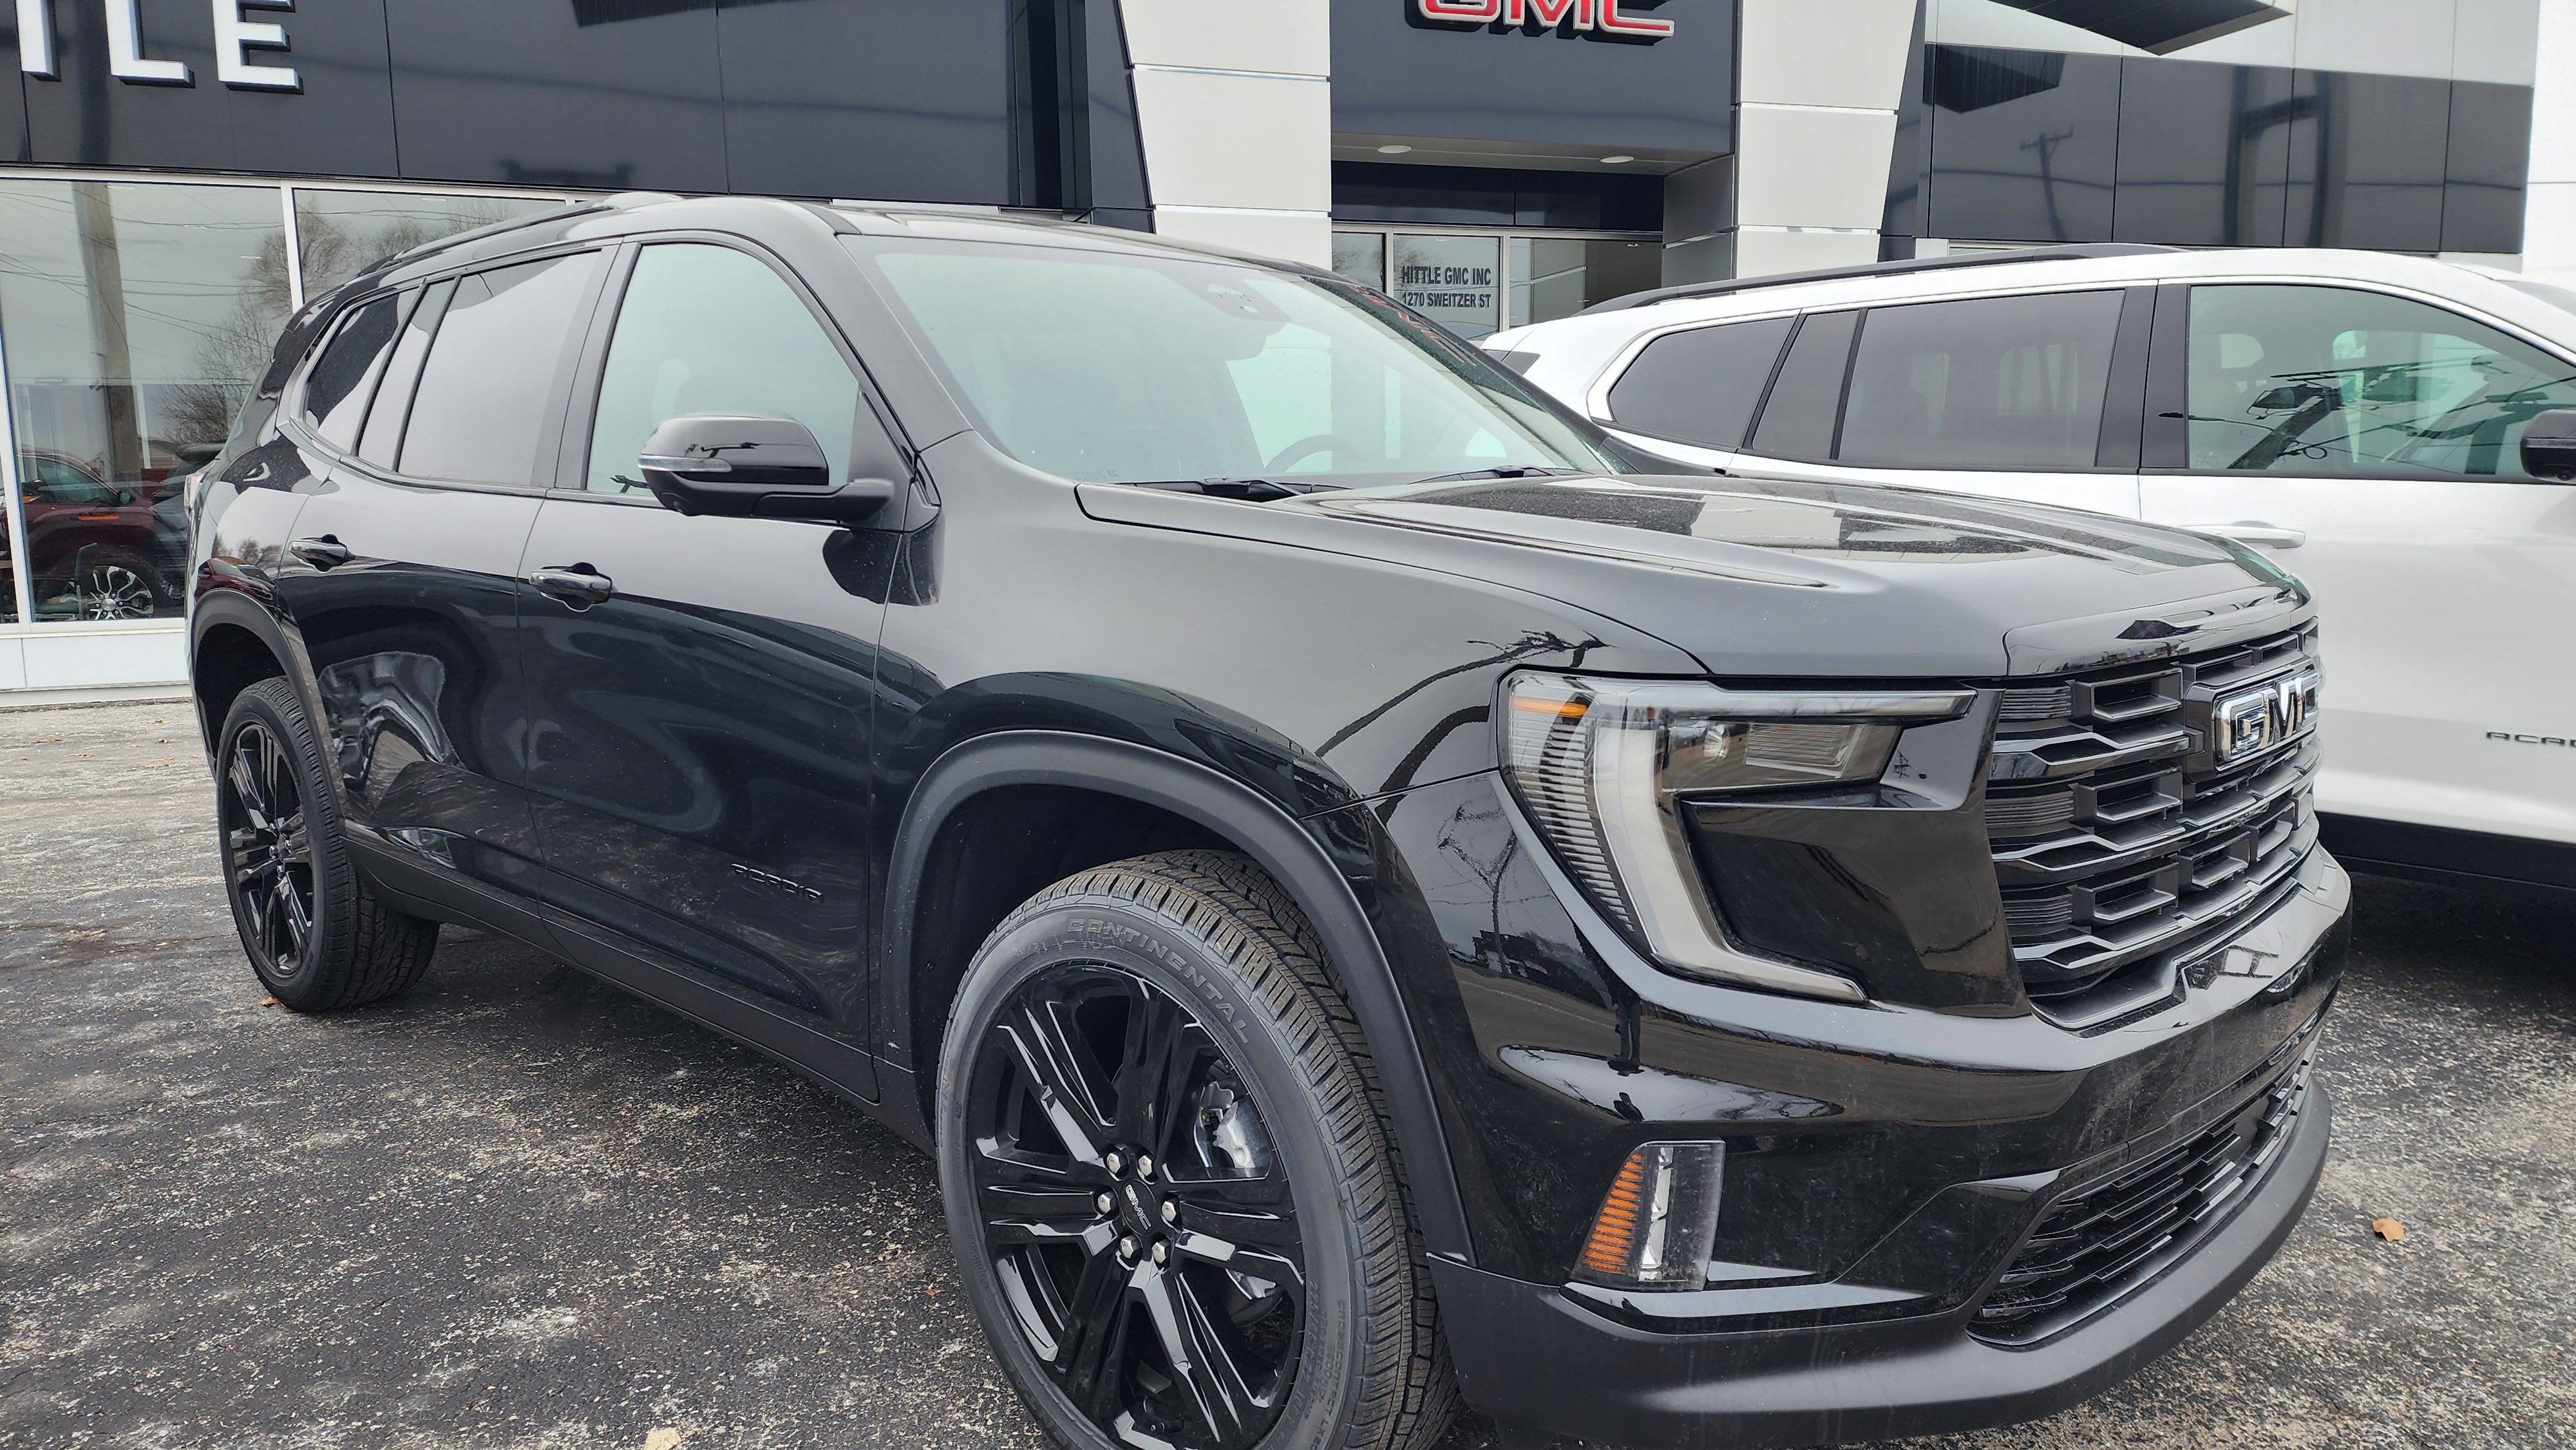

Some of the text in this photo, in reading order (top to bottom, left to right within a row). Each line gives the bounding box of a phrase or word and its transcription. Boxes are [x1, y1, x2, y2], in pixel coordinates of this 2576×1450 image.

[1401, 266, 1492, 285] HITTLE GMC INC
[1402, 292, 1492, 308] 1270 SWEITZER ST
[2217, 670, 2320, 761] GMC
[2486, 731, 2576, 748] ACA
[1067, 918, 1249, 1045] CONTINENTAL
[1125, 1184, 1151, 1230] GMC
